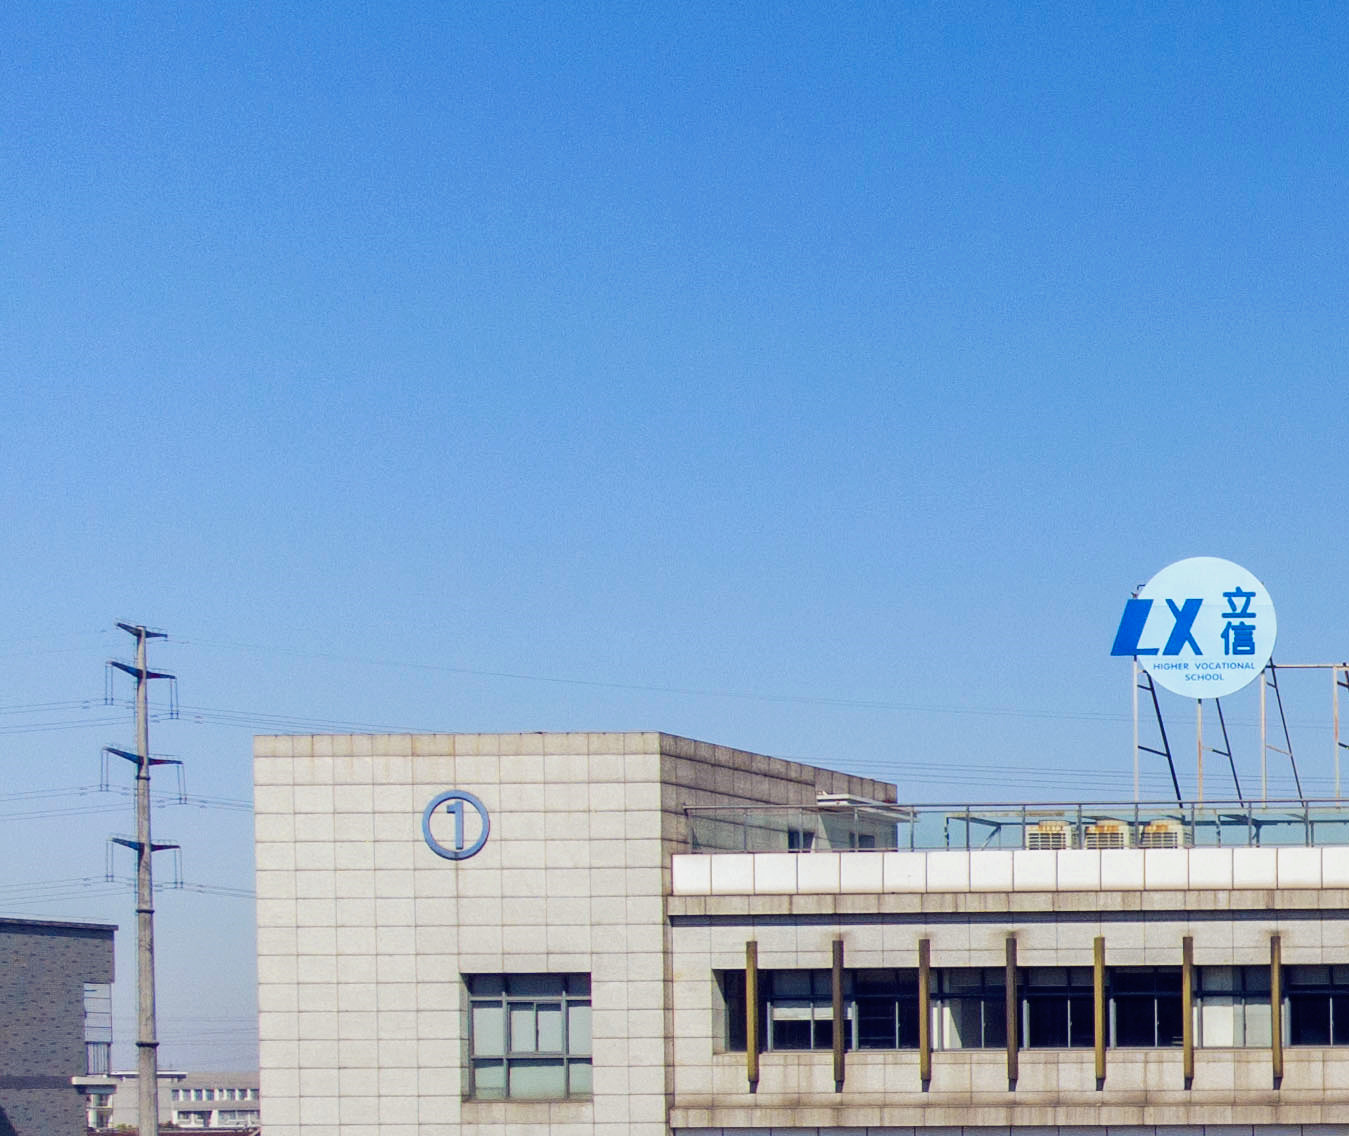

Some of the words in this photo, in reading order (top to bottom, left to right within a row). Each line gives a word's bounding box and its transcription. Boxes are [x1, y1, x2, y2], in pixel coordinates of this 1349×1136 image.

[1110, 598, 1204, 656] LX
[1220, 586, 1257, 656] 立信
[1153, 662, 1189, 671] HIGHER
[1195, 661, 1255, 670] VOCATIONAL
[1185, 673, 1225, 682] SCHOOL
